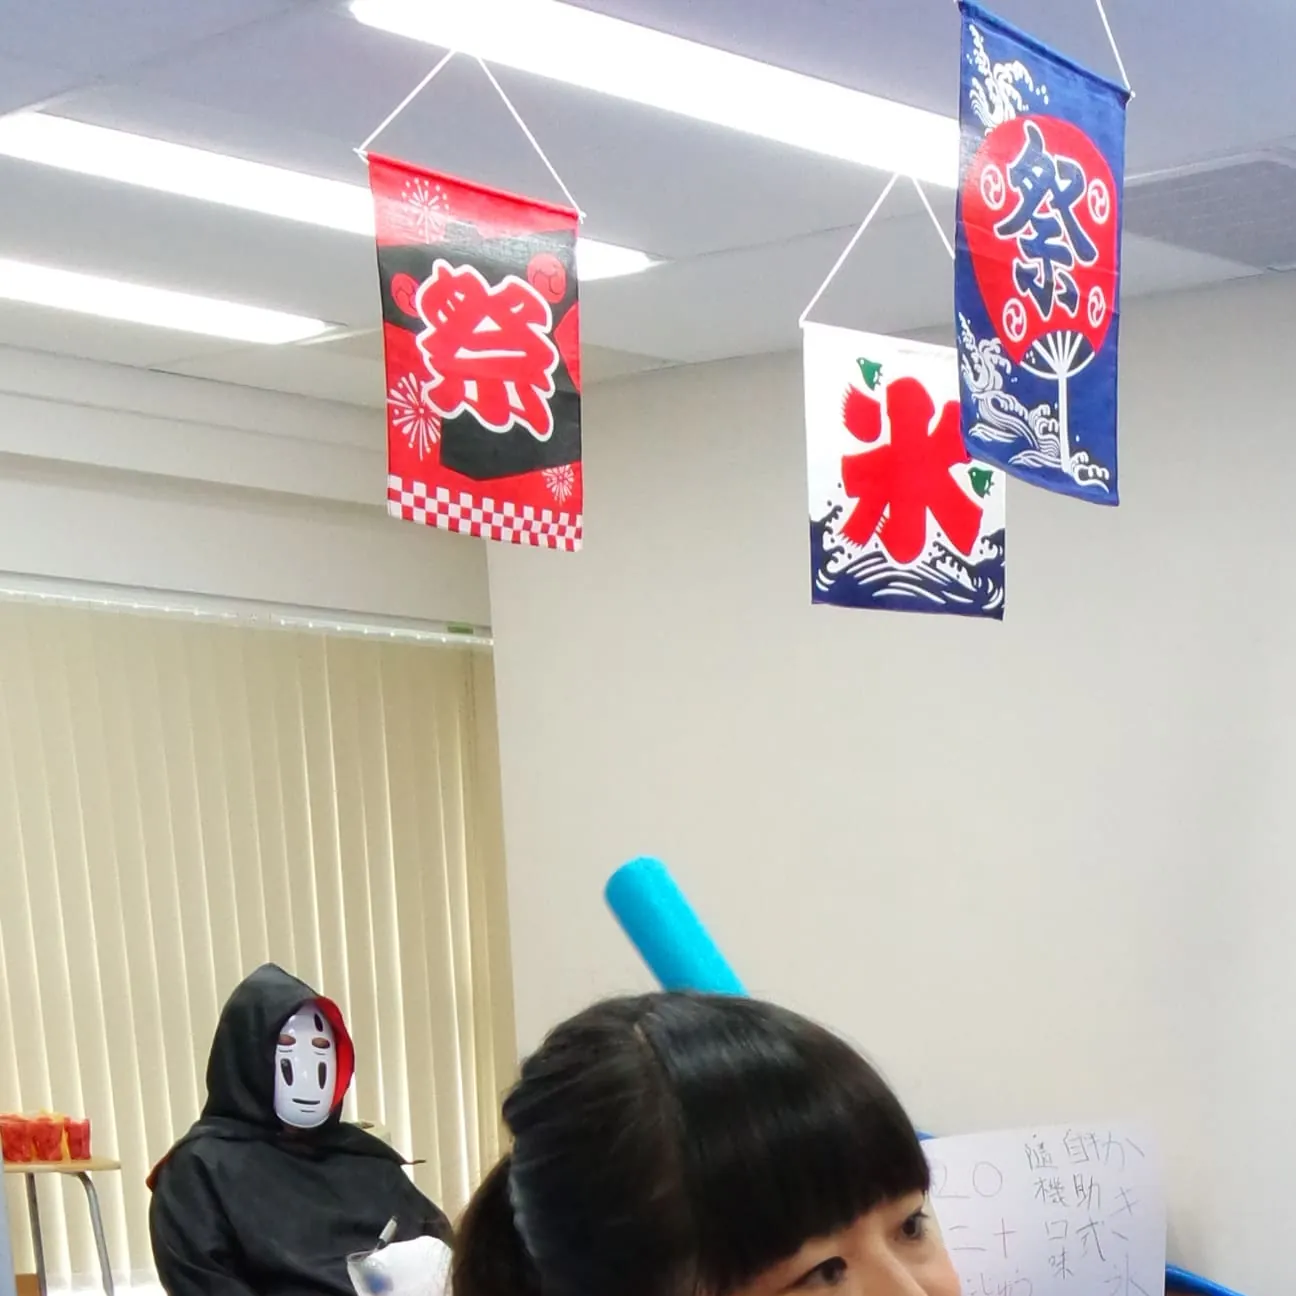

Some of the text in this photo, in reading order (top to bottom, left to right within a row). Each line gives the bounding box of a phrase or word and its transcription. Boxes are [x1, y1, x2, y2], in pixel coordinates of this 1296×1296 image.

[994, 119, 1098, 320] 祭
[415, 258, 560, 442] 祭
[840, 375, 983, 565] 氷
